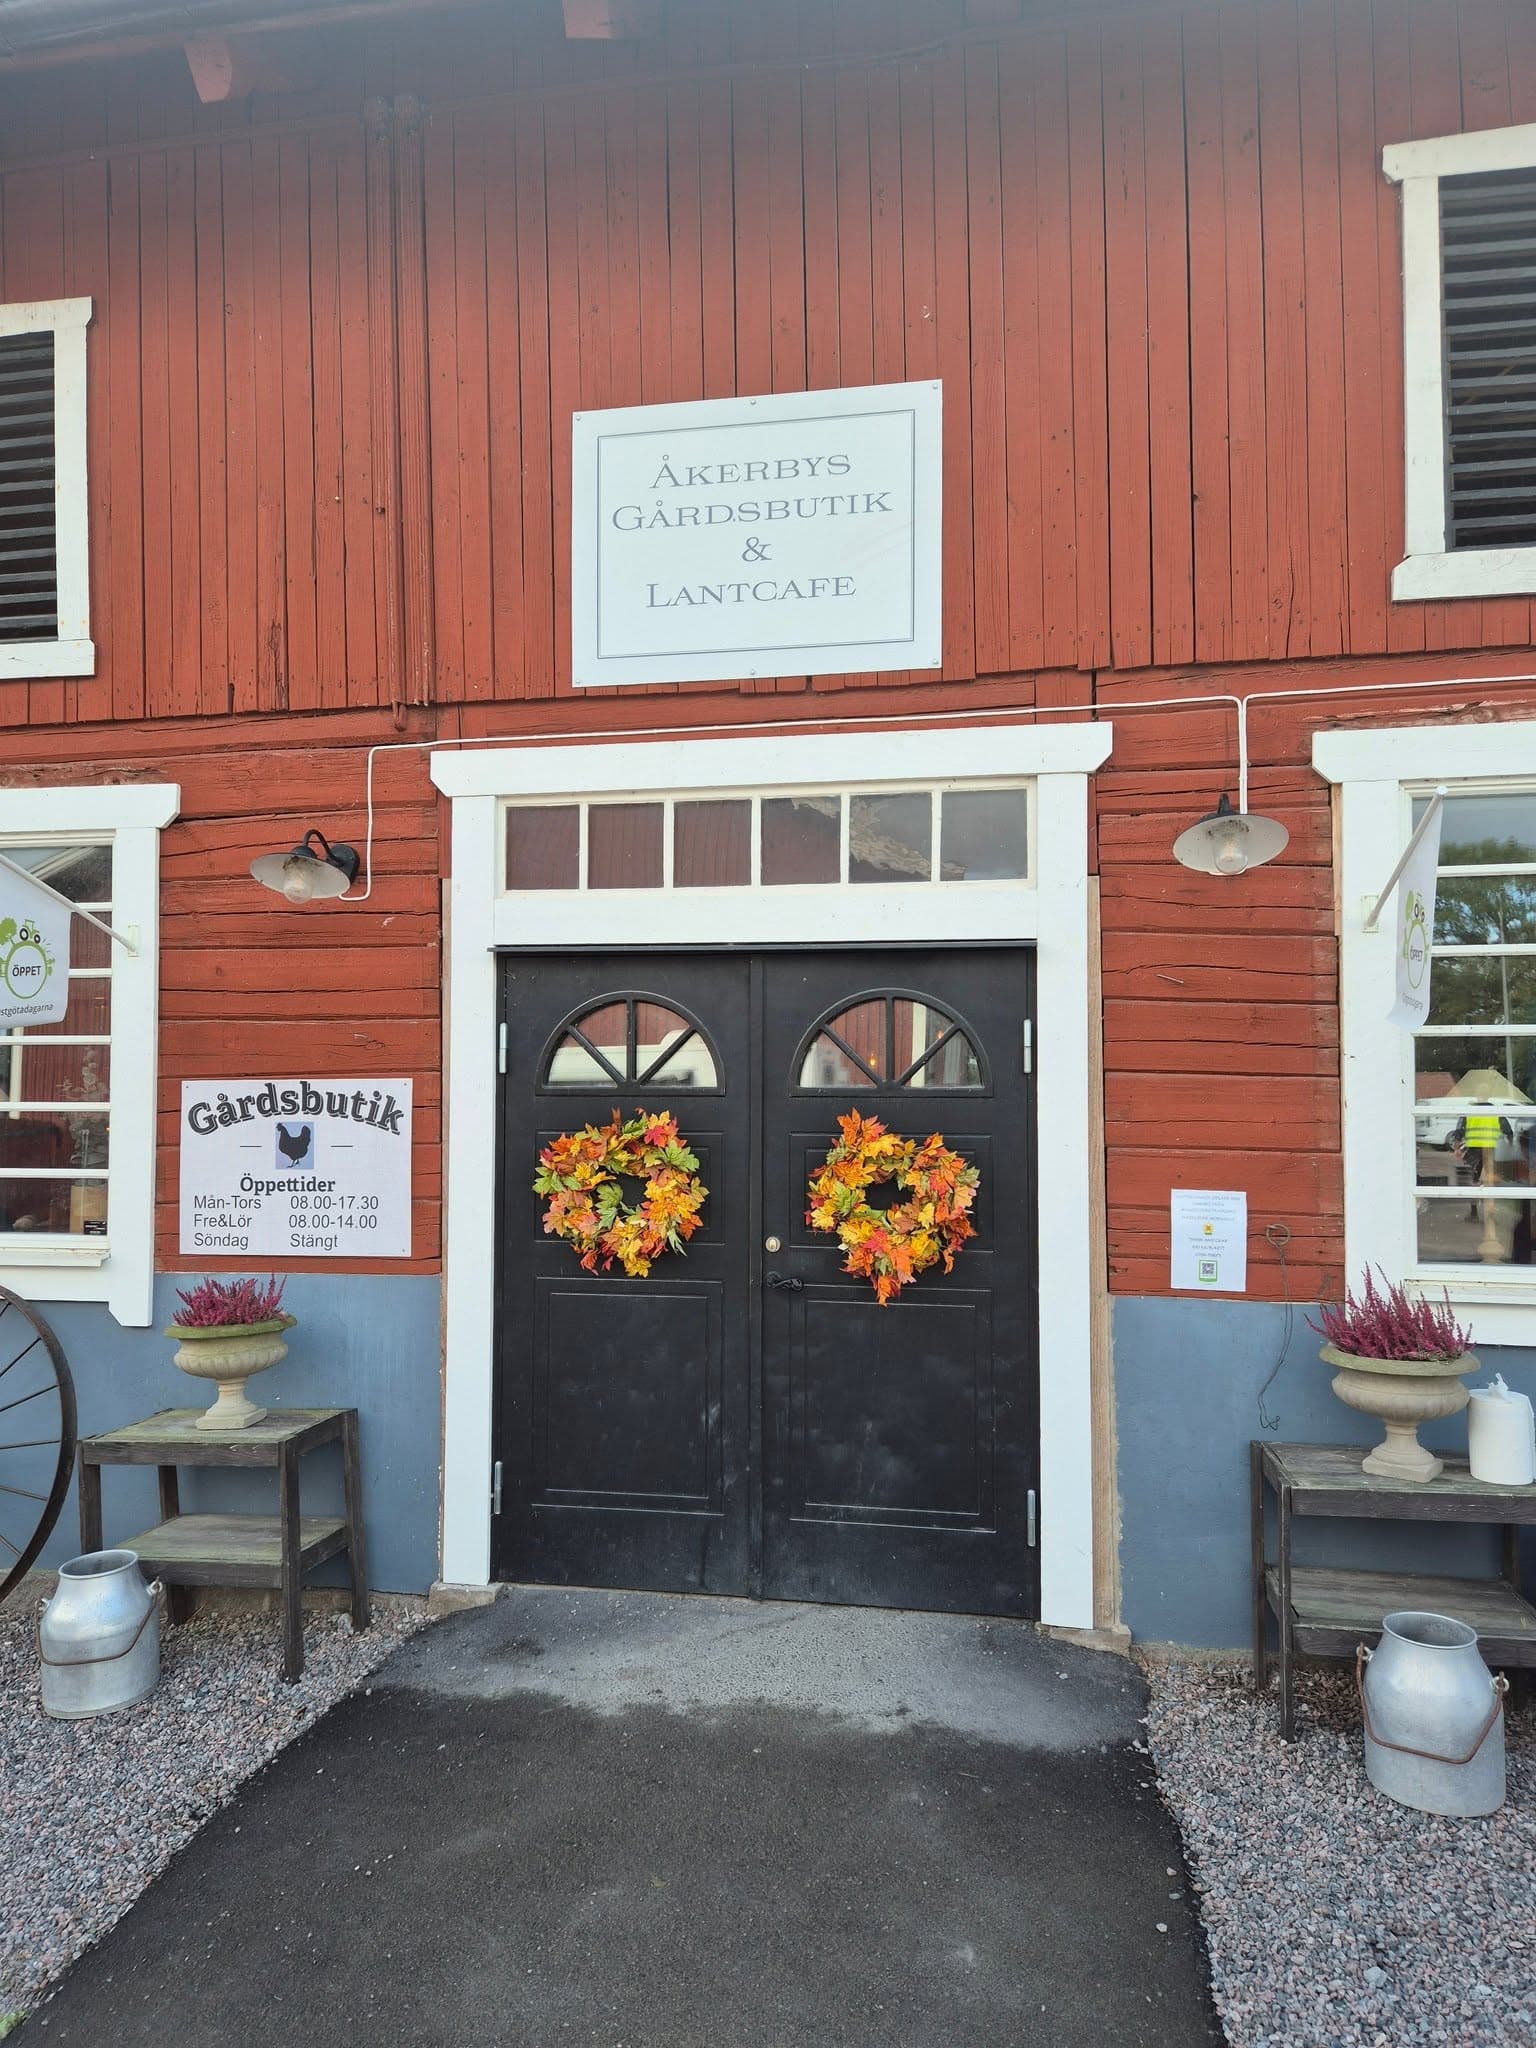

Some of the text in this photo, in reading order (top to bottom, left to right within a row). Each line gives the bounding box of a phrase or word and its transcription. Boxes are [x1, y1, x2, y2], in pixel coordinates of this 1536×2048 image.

[649, 454, 852, 489] ÅKERBYS
[612, 492, 893, 531] GÅRDSBUTIK
[741, 536, 772, 562] &
[646, 576, 857, 608] LANTCAFE
[12, 964, 42, 977] ÖPPET
[0, 1004, 53, 1017] stgötadagarna
[188, 1081, 404, 1135] Gårdsbutik
[240, 1173, 336, 1196] Öppettider
[193, 1195, 379, 1211] Mån-Tors 08.00-17.30
[193, 1213, 377, 1230] Fre&Lör 08.00-14.00
[194, 1233, 338, 1251] Söndag Stängt
